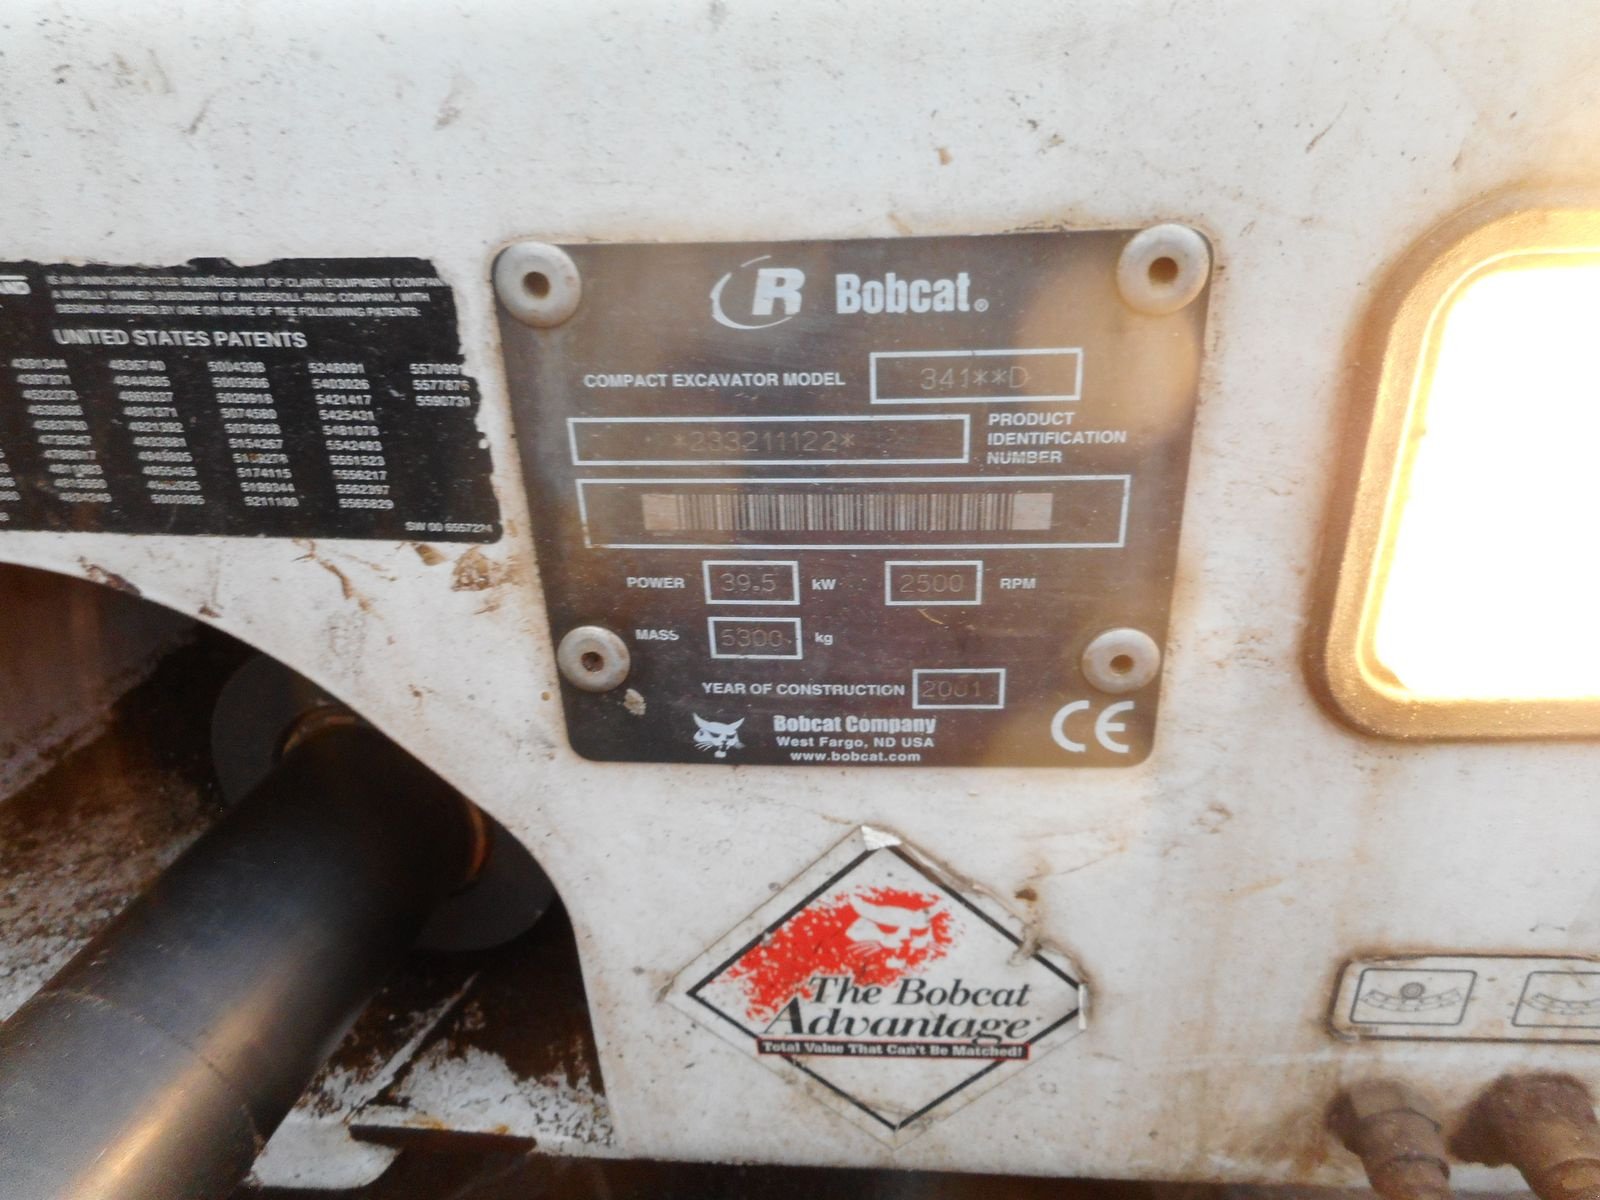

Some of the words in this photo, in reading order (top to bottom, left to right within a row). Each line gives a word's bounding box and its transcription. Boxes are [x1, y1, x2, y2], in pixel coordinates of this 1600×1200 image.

[180, 275, 237, 287] BUSINESS
[239, 277, 265, 287] UNIT
[266, 277, 283, 287] OF
[284, 278, 323, 287] CLARK
[324, 278, 391, 288] EQUIPMENT
[220, 292, 237, 301] OF
[176, 305, 202, 315] ONE
[256, 306, 272, 316] OF
[273, 306, 298, 316] THE
[298, 307, 365, 317] FOLLOWING
[366, 307, 422, 317] PATENTS:
[53, 329, 130, 345] UNITED
[132, 330, 211, 346] STATES
[213, 331, 308, 348] PATENTS
[583, 373, 668, 389] COMPACT
[672, 373, 779, 388] EXCAVATOR
[783, 372, 846, 387] MODEL
[988, 411, 1076, 427] PRODUCT
[987, 430, 1128, 446] IDENTIFICATION
[986, 450, 1063, 465] NUMBER
[626, 576, 686, 590] POWER
[720, 572, 777, 593] 39.5
[811, 578, 837, 591] kW
[900, 573, 964, 593] 2500
[999, 577, 1037, 590] RPM
[635, 628, 680, 642] MASS
[721, 628, 784, 648] 5300
[814, 631, 834, 646] kg
[701, 682, 746, 695] YEAR
[749, 683, 773, 696] OF
[775, 683, 906, 697] CONSTRUCTION
[772, 713, 842, 734] Bobcat
[844, 714, 937, 736] Company
[775, 735, 815, 748] West
[818, 736, 869, 751] Fargo,
[872, 736, 897, 749] ND
[901, 738, 935, 749] USA
[789, 750, 921, 763] www.bobcat.com
[808, 975, 883, 1007] The
[891, 977, 1032, 1009] Bobcat
[762, 996, 1031, 1044] Advantage
[763, 1040, 801, 1053] Total
[804, 1041, 844, 1055] Value
[848, 1042, 884, 1056] That
[885, 1043, 927, 1057] Can't
[929, 1045, 950, 1057] Be
[952, 1045, 1024, 1059] Matched!
